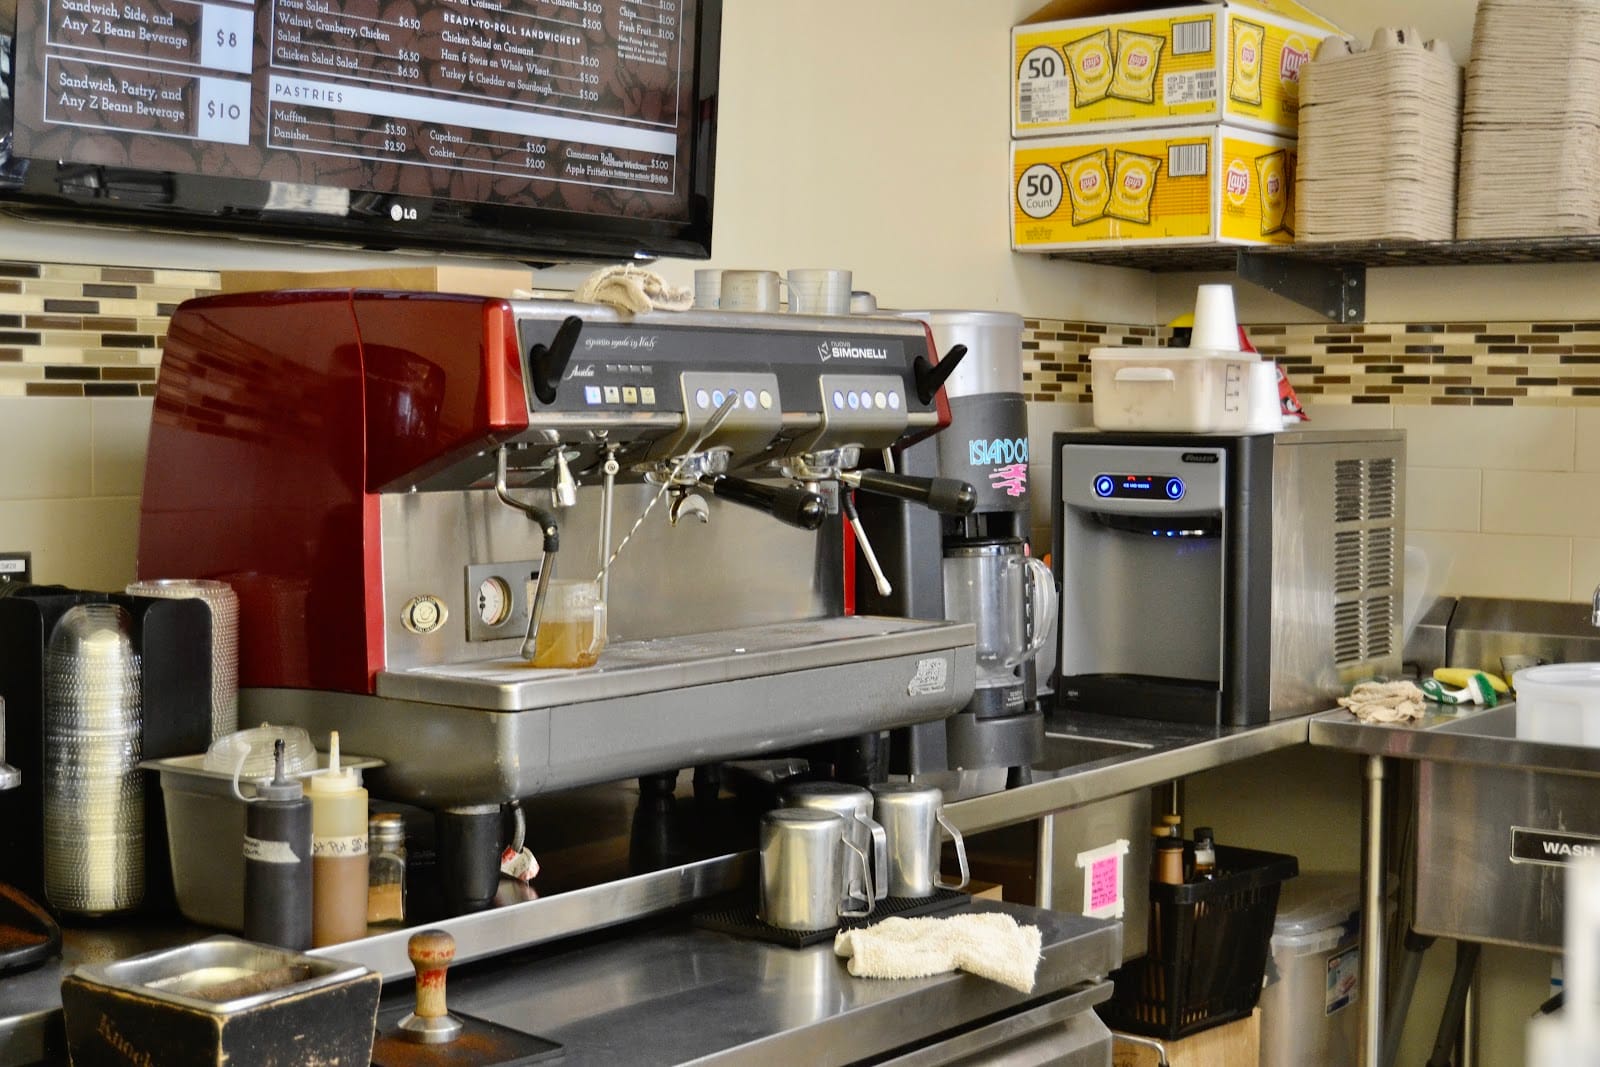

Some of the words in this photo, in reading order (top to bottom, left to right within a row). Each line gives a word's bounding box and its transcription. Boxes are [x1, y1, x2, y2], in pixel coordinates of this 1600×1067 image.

[62, 0, 120, 19] Sandwich,
[124, 5, 148, 24] Side,
[152, 12, 173, 26] and
[306, 0, 329, 14] Salad
[399, 16, 420, 30] $6.50
[443, 13, 517, 35] READY-TO-ROLL
[62, 16, 88, 35] Any
[92, 19, 101, 33] Z
[104, 22, 136, 39] Beans
[139, 27, 188, 48] Beverage
[217, 29, 237, 47] $8
[279, 13, 313, 29] Walnut,
[316, 20, 358, 38] Cranberry,
[360, 26, 390, 41] Chicken
[277, 29, 301, 43] Salad
[398, 49, 420, 63] $6.50
[441, 31, 470, 46] Chicken
[471, 35, 492, 49] Salad
[493, 43, 502, 51] on
[503, 42, 534, 57] Croissant
[276, 47, 310, 62] Chicken
[311, 52, 334, 66] Salad
[336, 56, 359, 69] Salad
[398, 65, 419, 79] $6.50
[441, 49, 460, 62] Ham
[461, 52, 467, 63] &
[469, 53, 488, 67] Swiss
[489, 60, 499, 68] on
[500, 59, 524, 72] Whole
[526, 62, 550, 77] Wheat
[1028, 56, 1055, 79] 50
[59, 72, 118, 93] Sandwich,
[121, 80, 158, 101] Pastry,
[161, 88, 182, 102] and
[275, 83, 343, 103] PASTRIES
[440, 66, 467, 83] Turkey
[468, 71, 474, 82] &
[476, 73, 505, 87] Cheddar
[507, 80, 516, 88] on
[517, 81, 553, 97] Sourdough
[59, 92, 86, 111] Any
[89, 95, 99, 109] Z
[101, 98, 133, 114] Beans
[136, 101, 185, 122] Beverage
[207, 99, 241, 120] $10
[274, 109, 307, 123] Muffins
[384, 122, 407, 136] $3.50
[274, 126, 310, 141] Danishes
[429, 146, 456, 158] Cookies
[526, 142, 546, 154] $3.00
[566, 147, 599, 161] Cinnamon
[565, 163, 586, 176] Apple
[1026, 174, 1053, 197] 50
[404, 207, 417, 220] LG
[1026, 198, 1053, 209] Count
[831, 347, 887, 359] SIMONELLI
[1542, 841, 1595, 857] WASH
